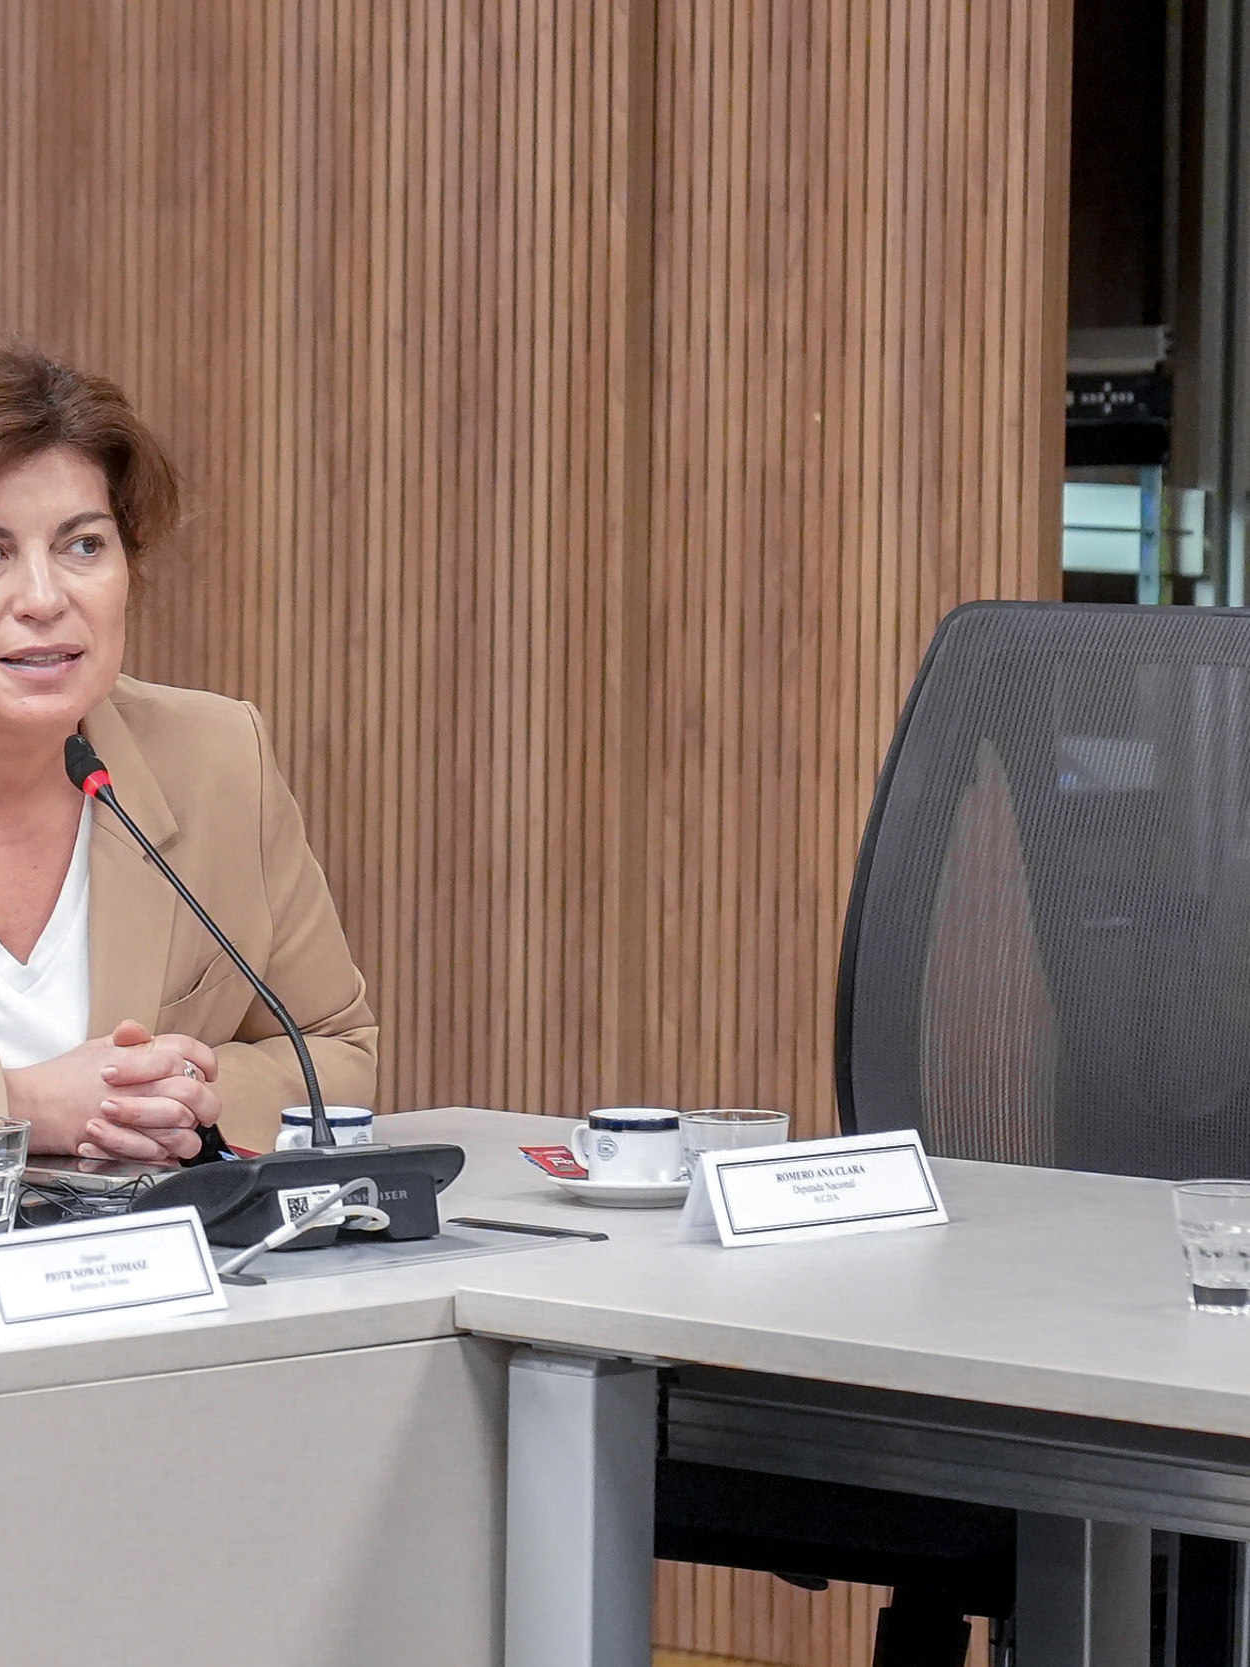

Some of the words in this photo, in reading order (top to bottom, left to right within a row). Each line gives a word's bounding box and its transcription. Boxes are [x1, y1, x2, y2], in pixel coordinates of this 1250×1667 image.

[776, 1170, 815, 1182] ROMERO
[817, 1168, 834, 1177] ANA
[835, 1165, 865, 1175] CLARA
[45, 1271, 72, 1282] PIOTR
[111, 1259, 147, 1272] TOMASZ
